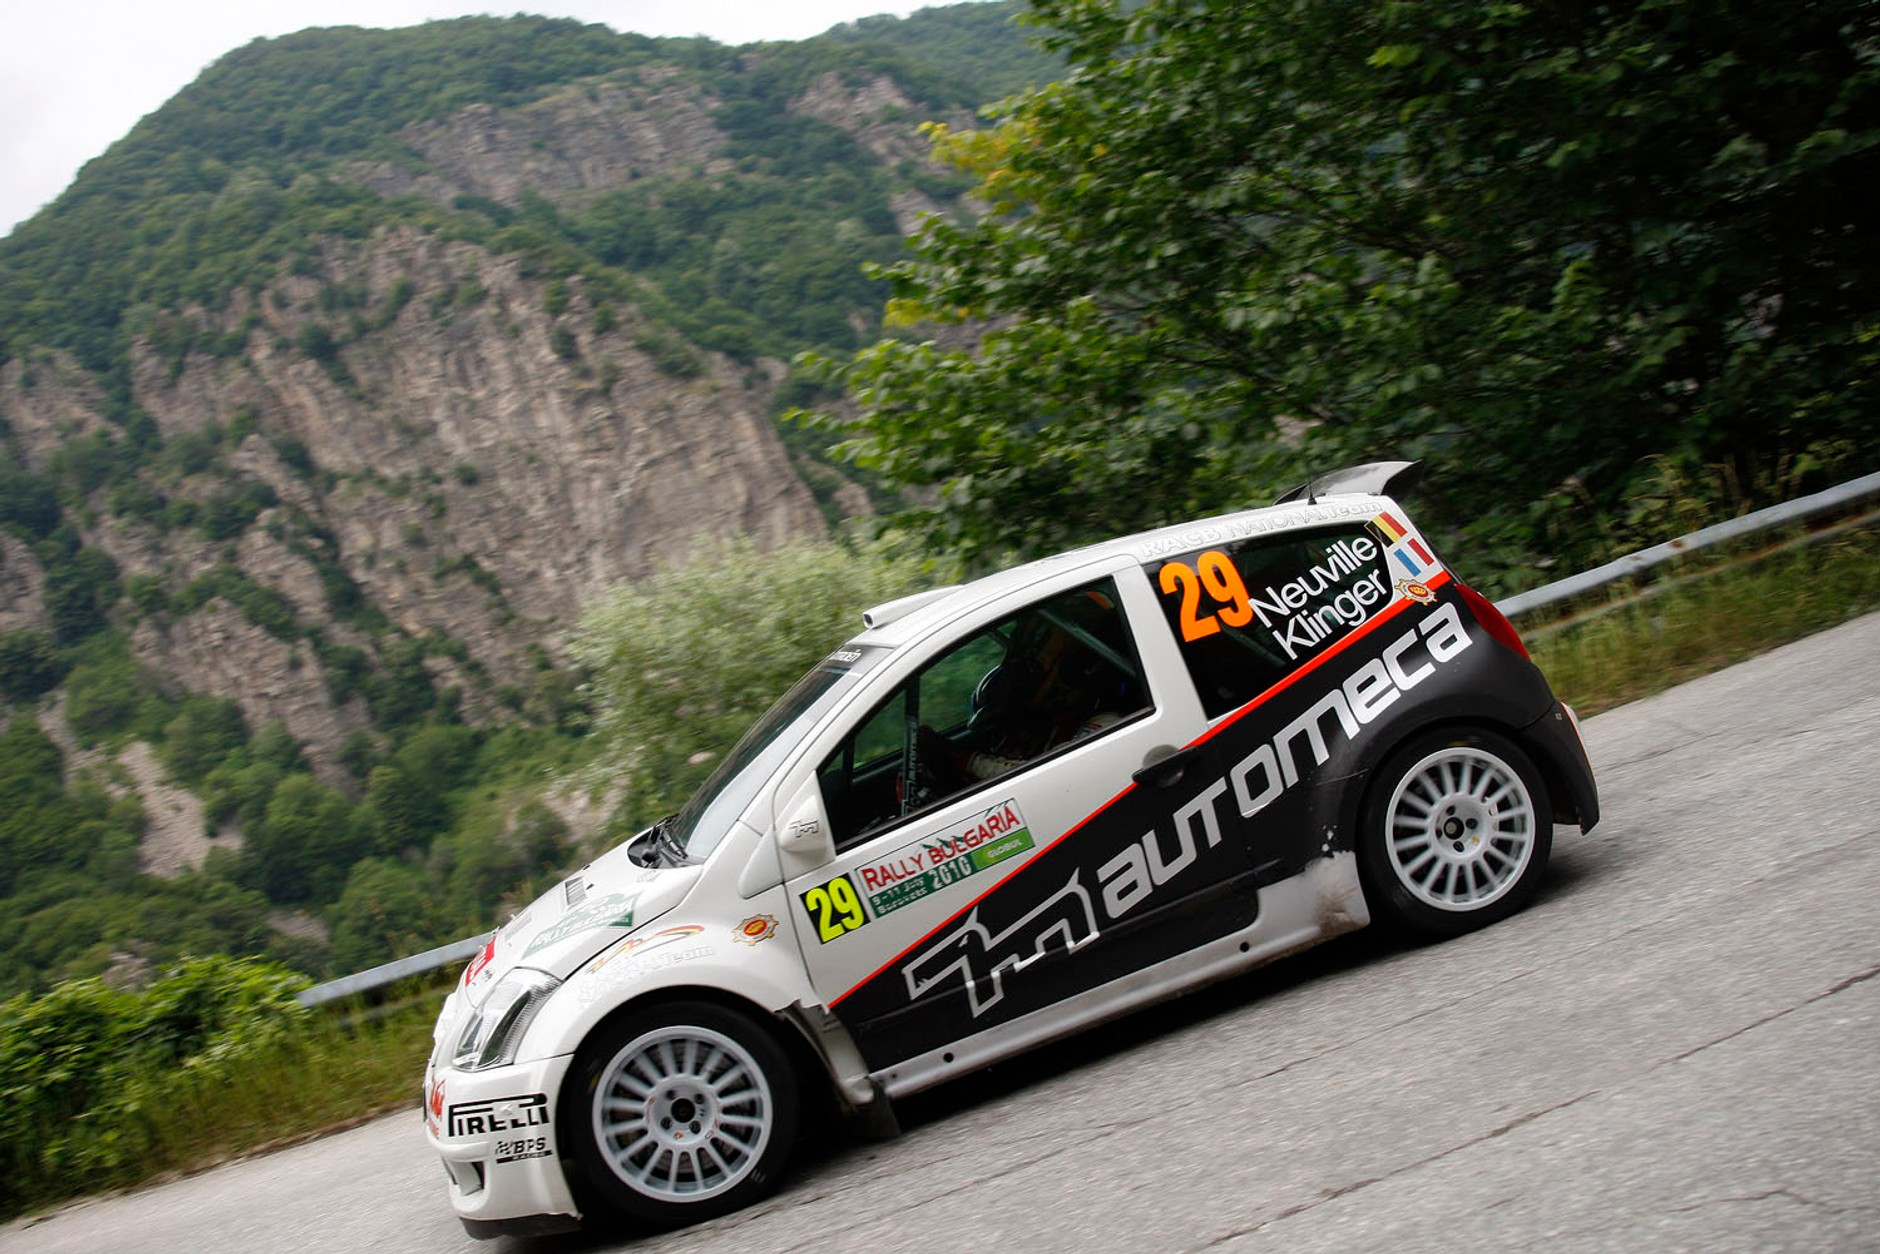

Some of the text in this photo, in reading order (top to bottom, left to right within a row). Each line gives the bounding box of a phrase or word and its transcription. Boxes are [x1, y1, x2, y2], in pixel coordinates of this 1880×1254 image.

[1141, 526, 1222, 558] RACB
[1248, 536, 1379, 627] Neuville
[1158, 550, 1253, 643] 29
[1272, 568, 1388, 661] Klinger
[861, 805, 1021, 892] RALLY BULGARIA
[928, 855, 972, 887] 2010
[805, 877, 865, 943] 29
